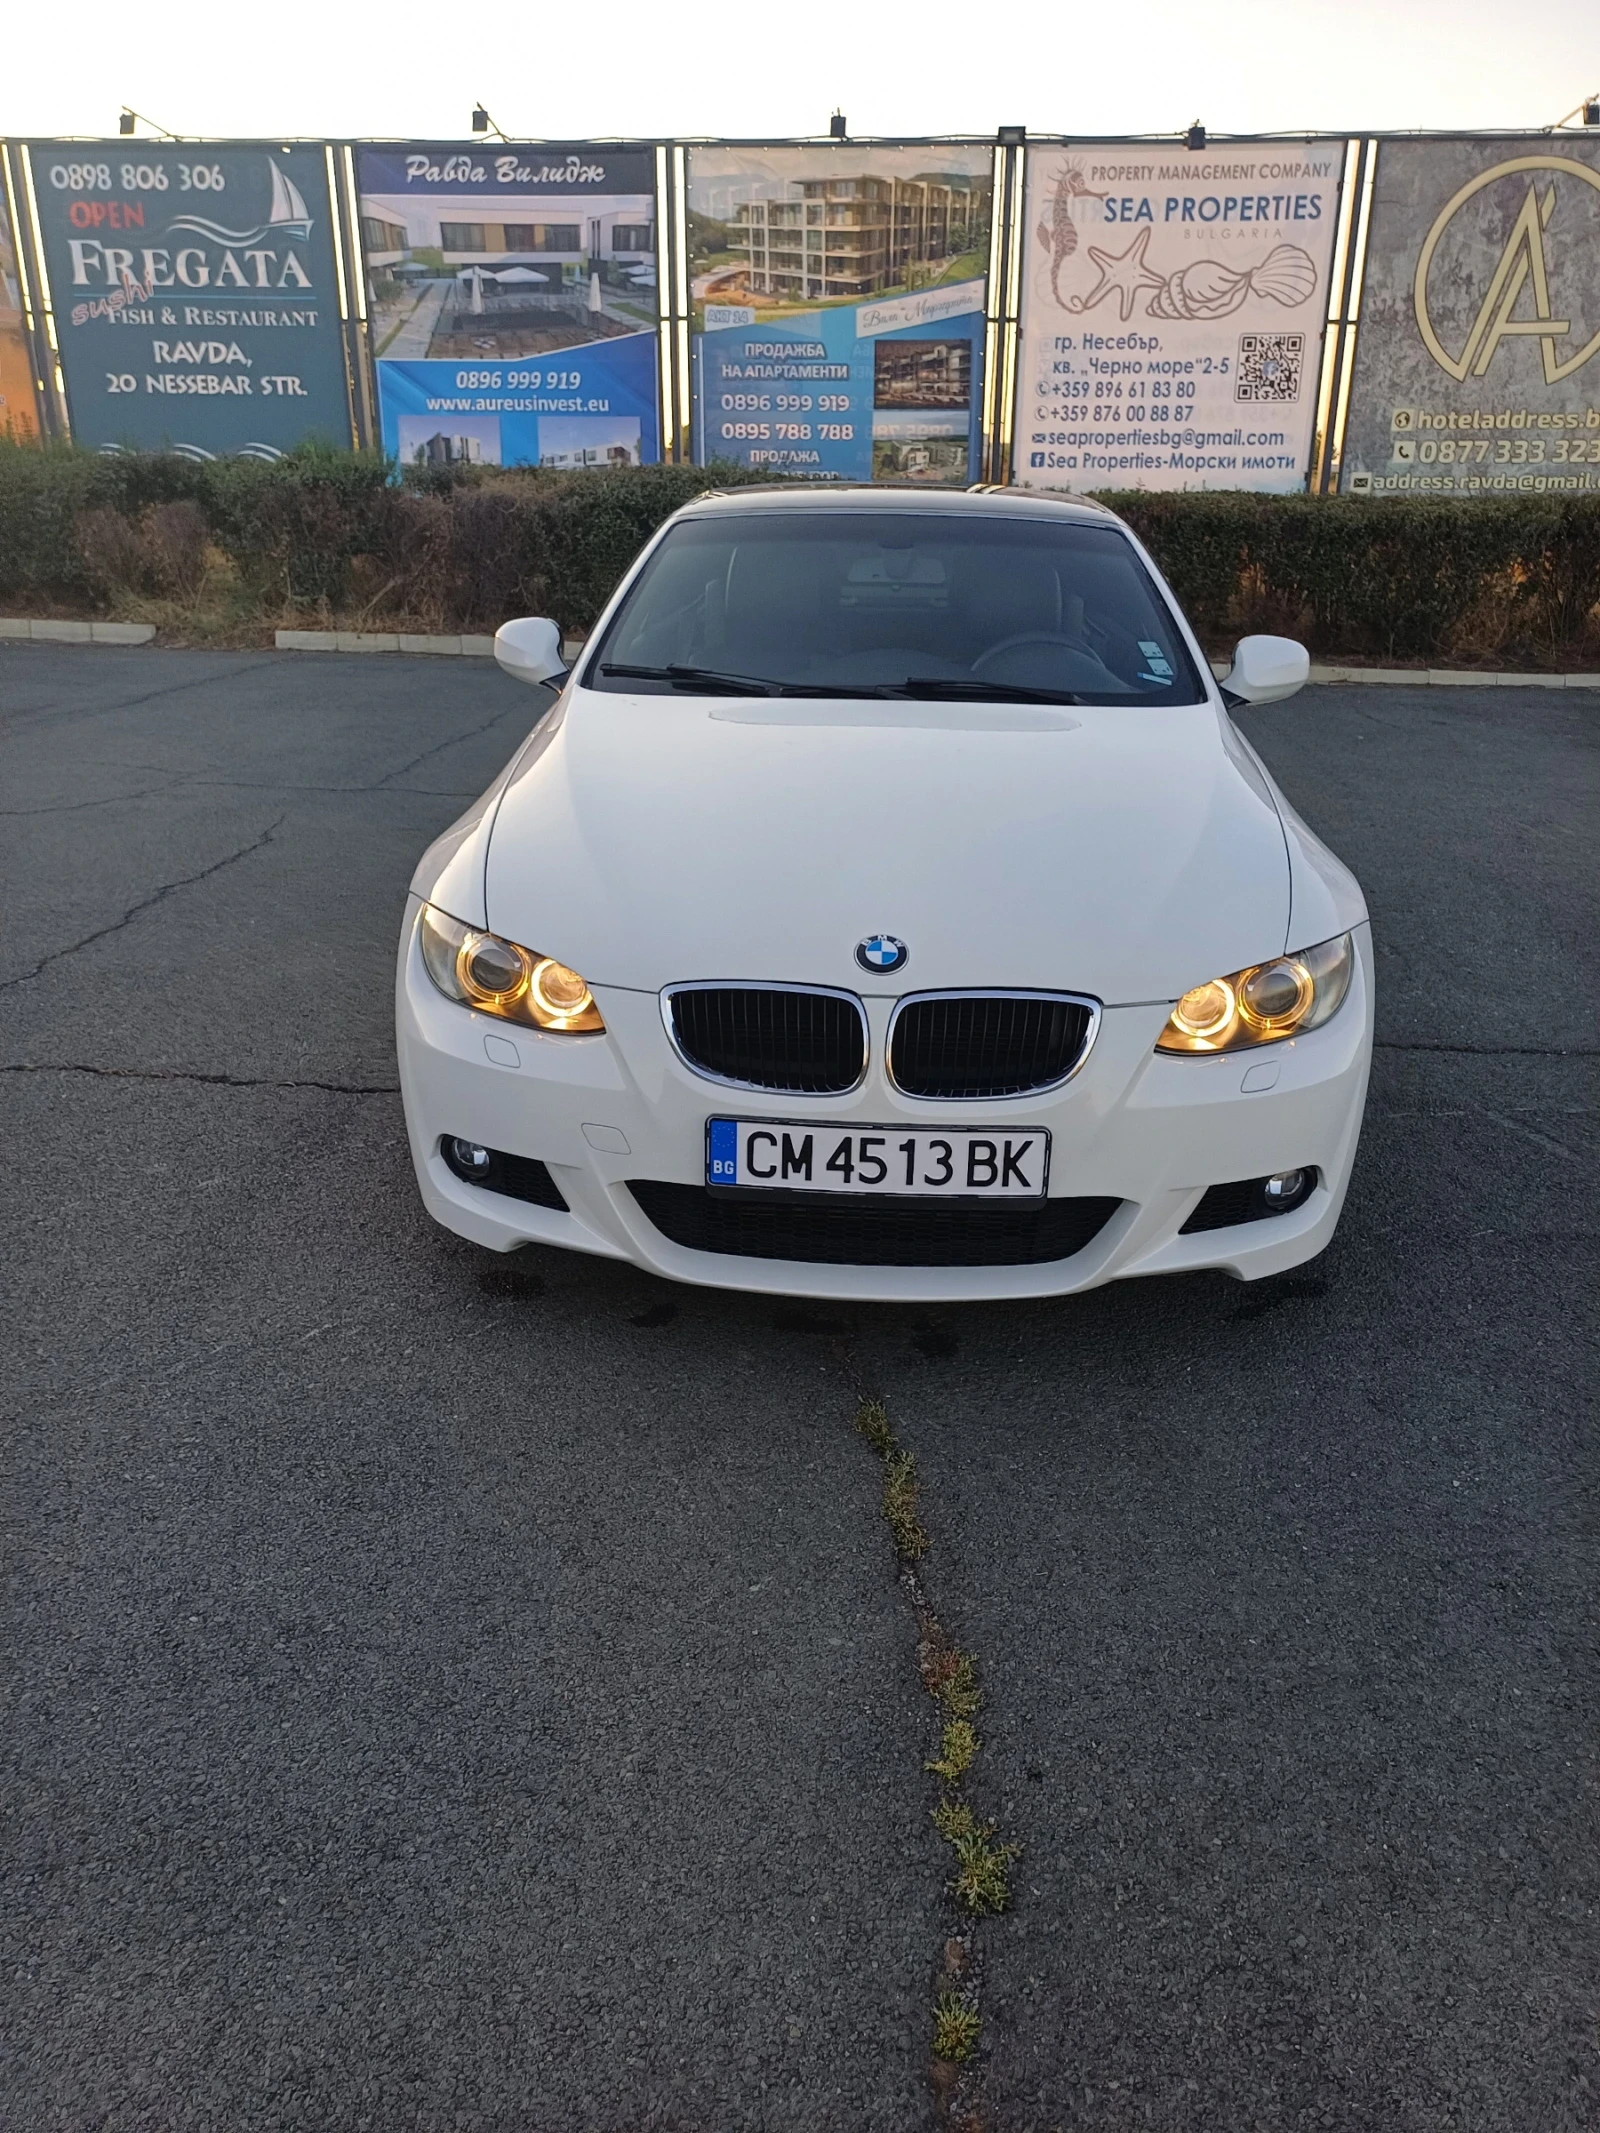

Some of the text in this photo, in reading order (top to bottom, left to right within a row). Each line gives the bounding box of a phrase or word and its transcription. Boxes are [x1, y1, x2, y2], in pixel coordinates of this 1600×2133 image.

[50, 163, 225, 191] 0898 806 306
[404, 155, 606, 184] Равда Вилидж
[1091, 162, 1332, 182] PROPERTY MANAGEMENT COMPANY
[69, 201, 145, 229] OPEN
[1103, 194, 1322, 223] SEA PROPERTIES
[1183, 227, 1283, 240] BULGARIA
[67, 239, 313, 288] FREGATA
[71, 269, 155, 326] sushi
[107, 306, 319, 327] FISH & RESTAURANT
[707, 309, 749, 324] АКТ 14
[744, 343, 826, 360] ПРОДАЖБА
[1054, 332, 1164, 353] гр. Несебър,
[153, 340, 253, 368] RAVDA,
[721, 365, 848, 378] НА АПАРТАМЕНТИ
[1052, 360, 1076, 374] кв.
[106, 373, 308, 396] 20 NESSEBAR STR.
[456, 371, 581, 390] 0896 999 919
[1052, 381, 1196, 398] +359 896 61 83 80
[425, 395, 610, 412] www.aureusinvest.eu
[721, 394, 850, 412] 0896 999 919
[1050, 405, 1194, 422] +359 876 00 88 87
[721, 423, 854, 440] 0895 788 788
[1048, 428, 1285, 449] seapropertiesbg@gmail.com
[750, 450, 820, 465] ПРОДАЖА
[1046, 451, 1077, 469] Sea
[1241, 456, 1296, 470] имоти
[1419, 439, 1600, 464] 0877 333 323
[1373, 472, 1600, 493] address.ravda@gmail.
[860, 934, 906, 947] BMW
[713, 1160, 735, 1175] BG
[746, 1131, 1033, 1188] CM 4513 BK
